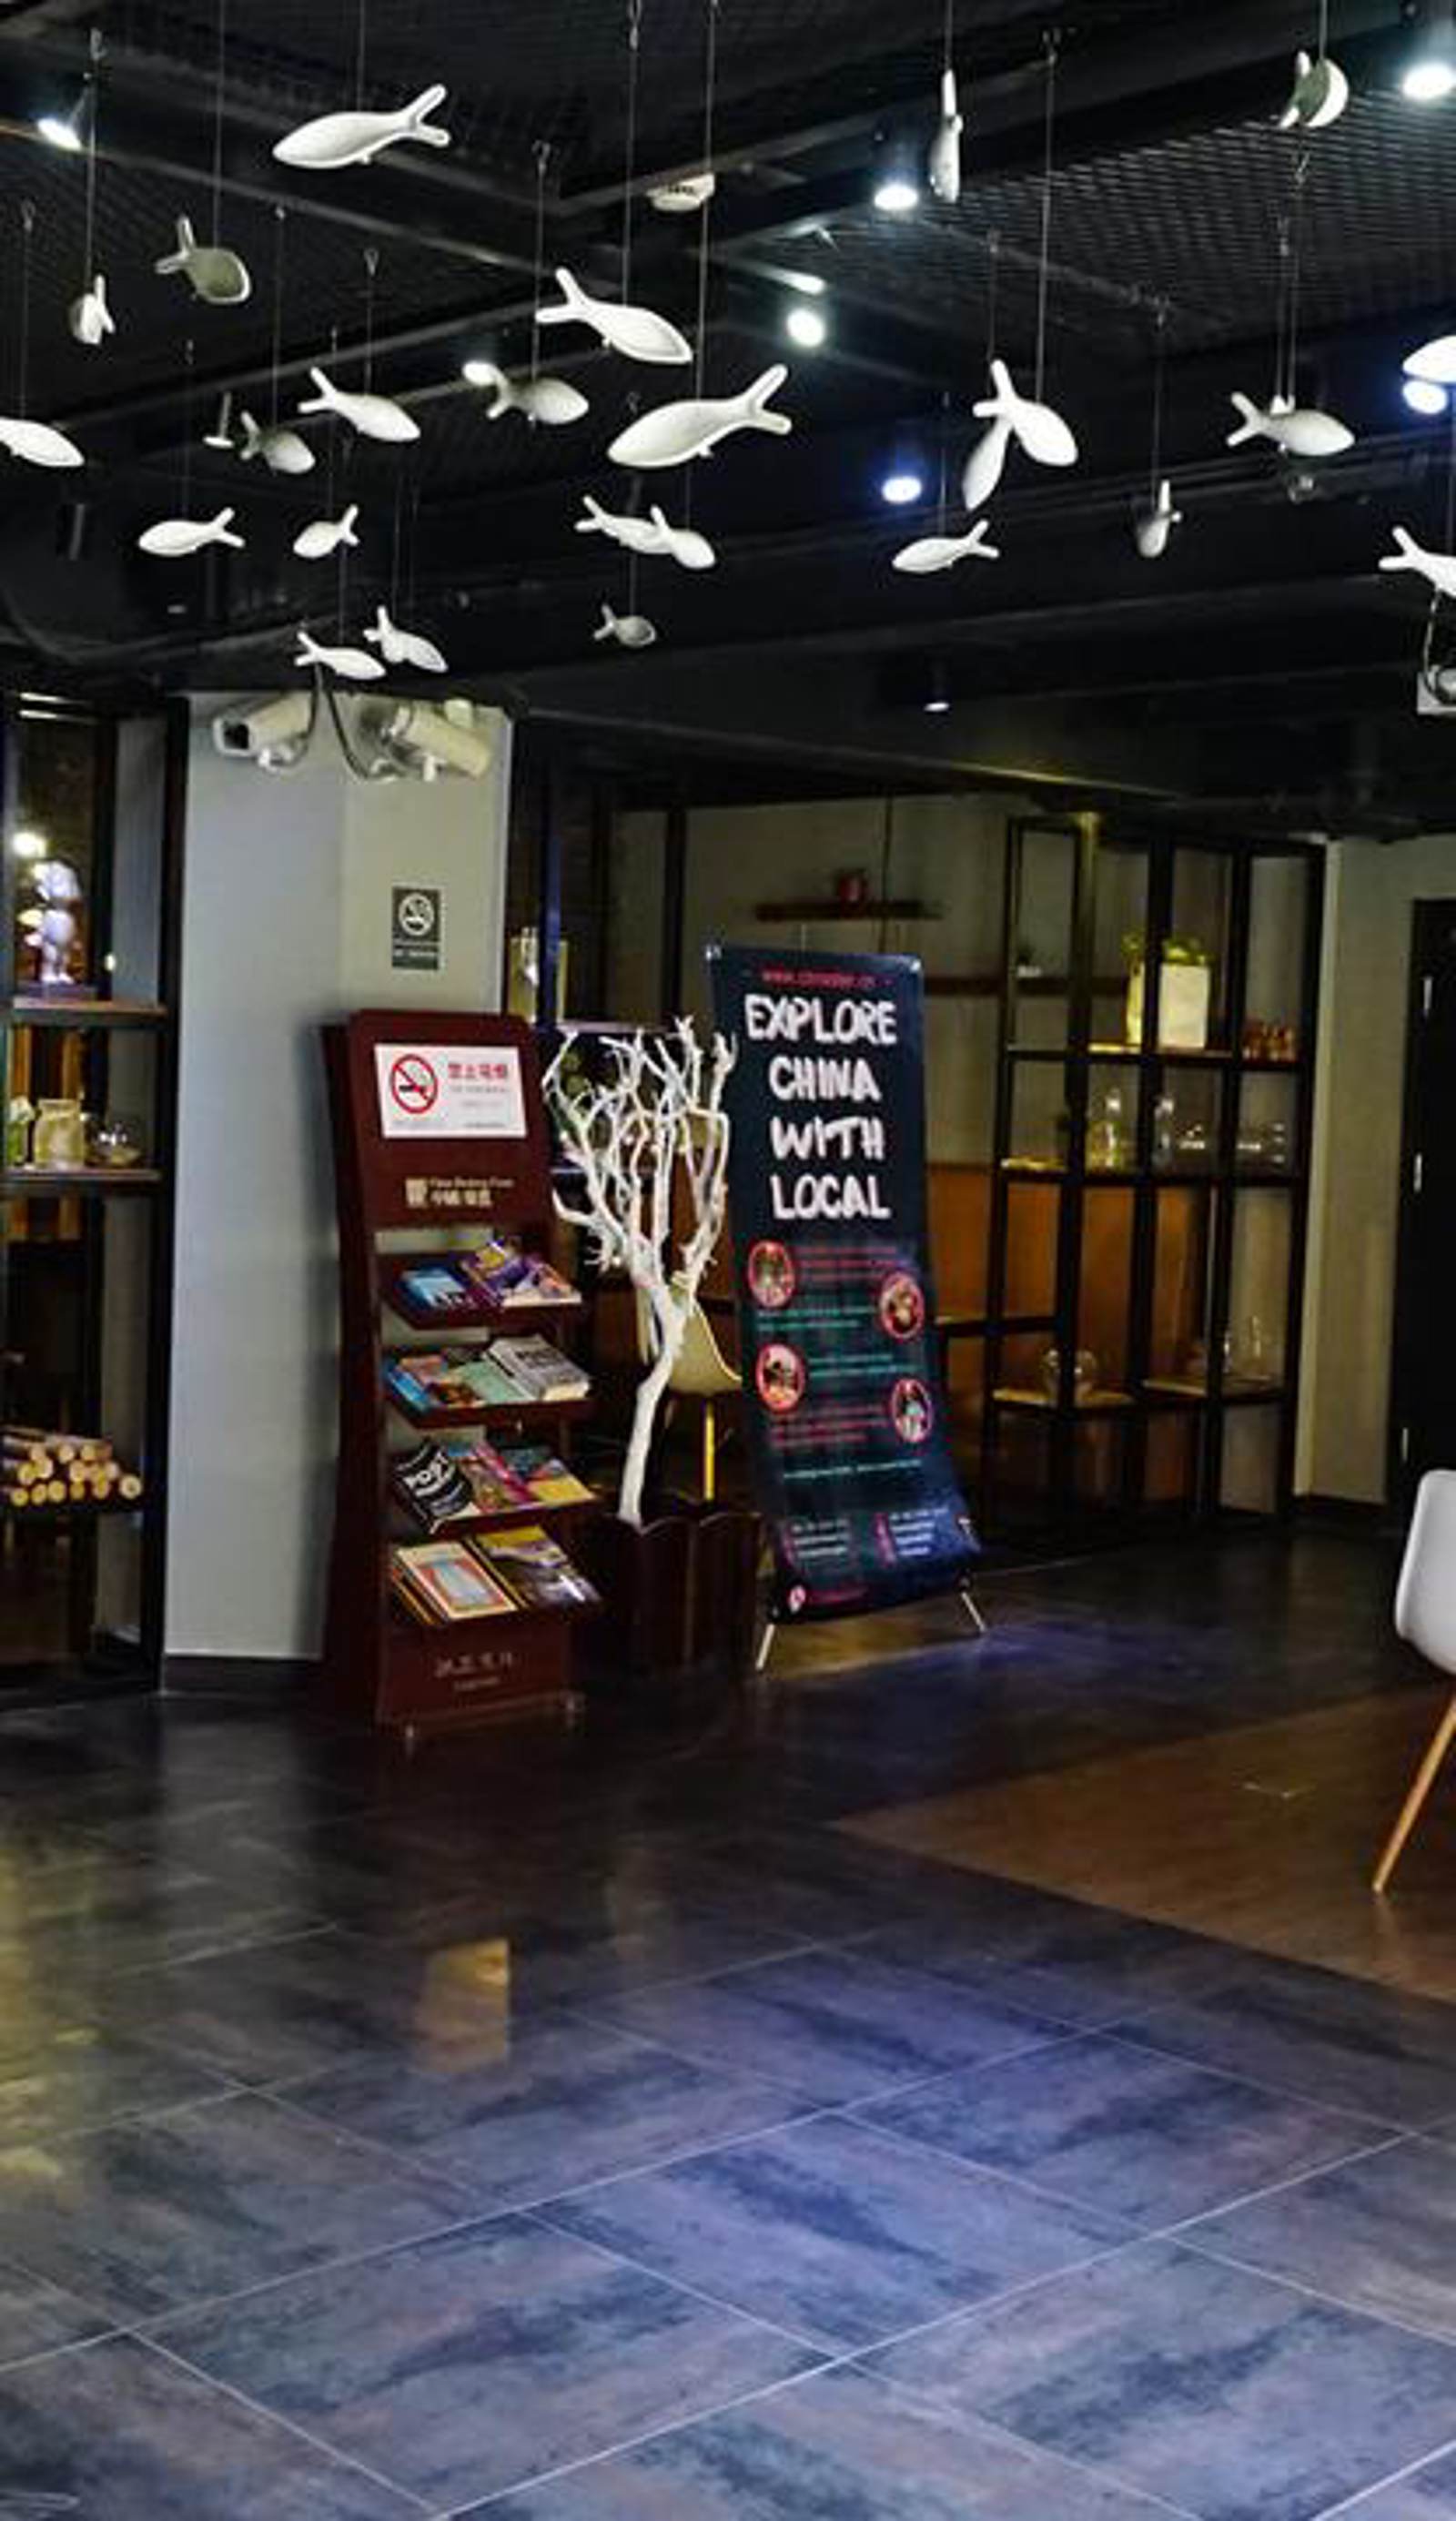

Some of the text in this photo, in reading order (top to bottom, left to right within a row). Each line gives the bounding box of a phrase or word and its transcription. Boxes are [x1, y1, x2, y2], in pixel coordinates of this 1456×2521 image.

[744, 993, 897, 1045] EXPLORE
[769, 1055, 882, 1101] CHINA
[770, 1116, 885, 1159] WITH
[770, 1174, 892, 1220] LOCAL
